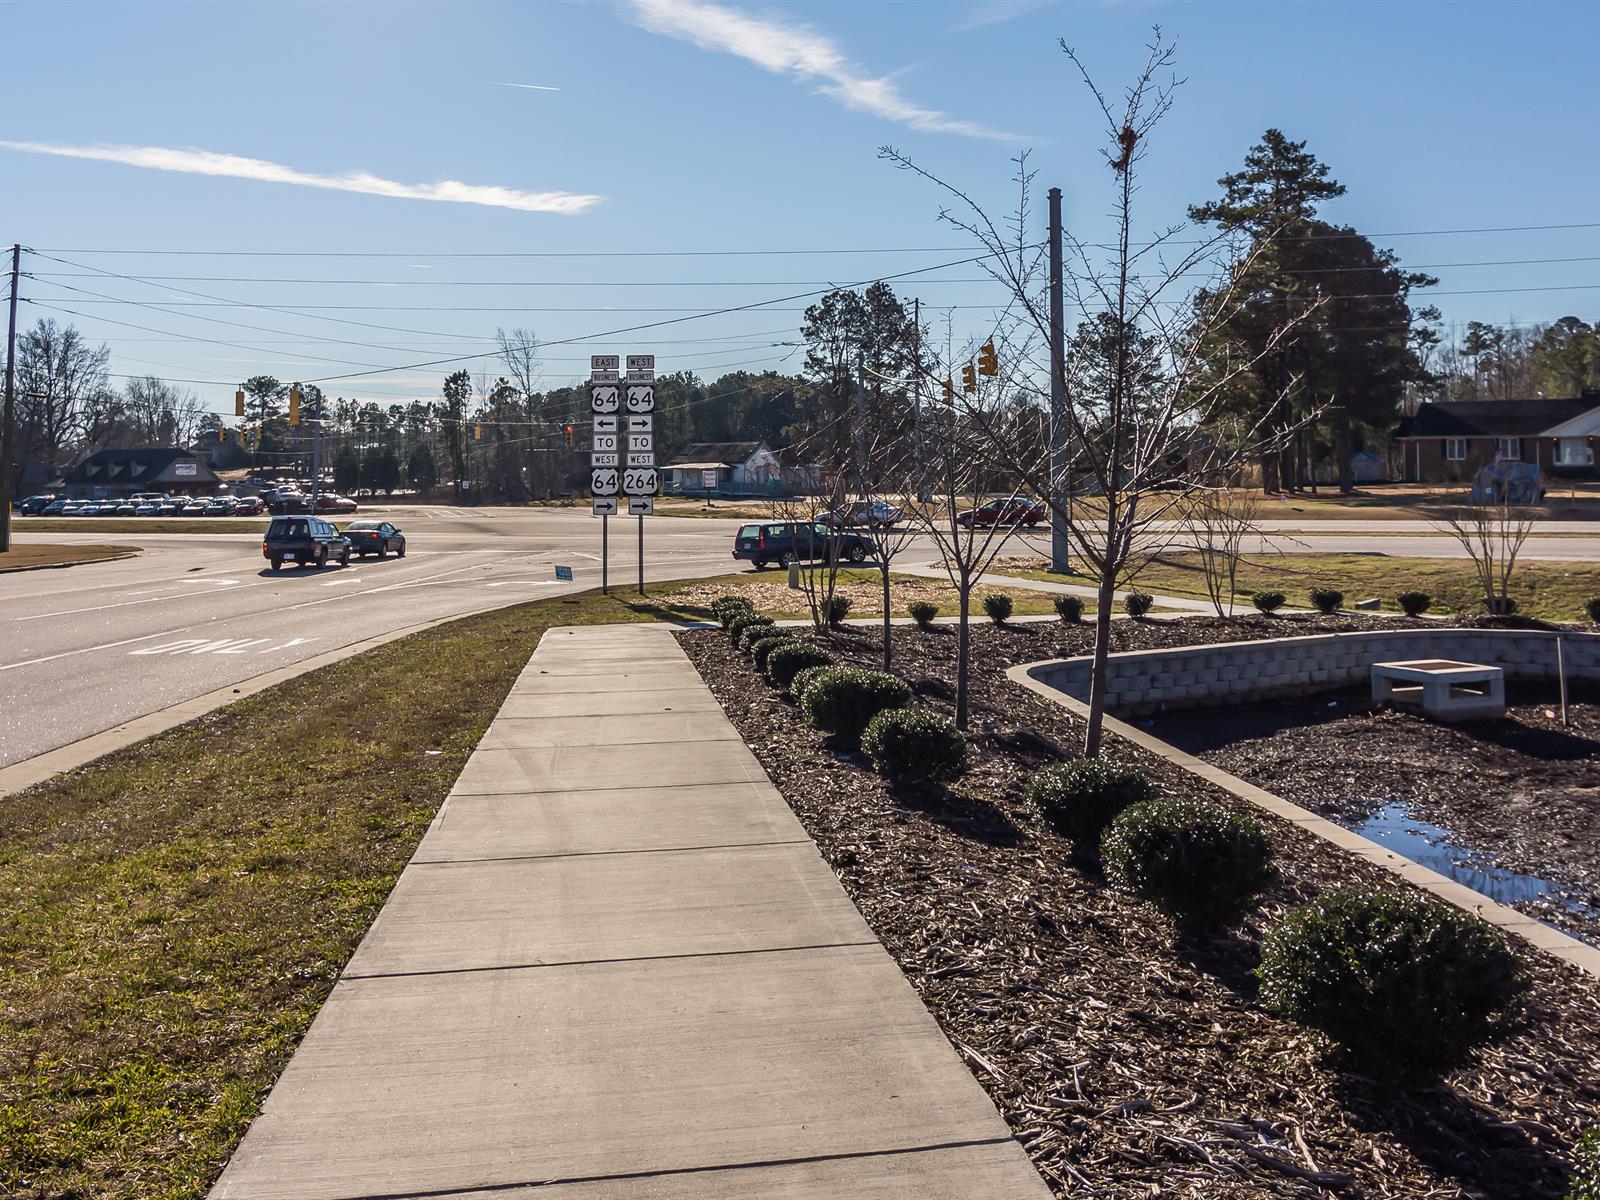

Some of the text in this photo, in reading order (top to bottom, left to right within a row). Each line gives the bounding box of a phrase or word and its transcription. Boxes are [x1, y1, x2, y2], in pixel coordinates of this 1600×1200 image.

[595, 358, 615, 367] EAST
[630, 357, 652, 366] WEST
[628, 373, 652, 381] BUSINESS
[594, 391, 617, 407] 64
[629, 391, 652, 407] 64
[597, 437, 614, 448] TO
[632, 437, 649, 448] TO
[595, 455, 616, 464] WEST
[630, 455, 651, 464] WEST
[594, 474, 617, 490] 64
[625, 473, 655, 489] 264
